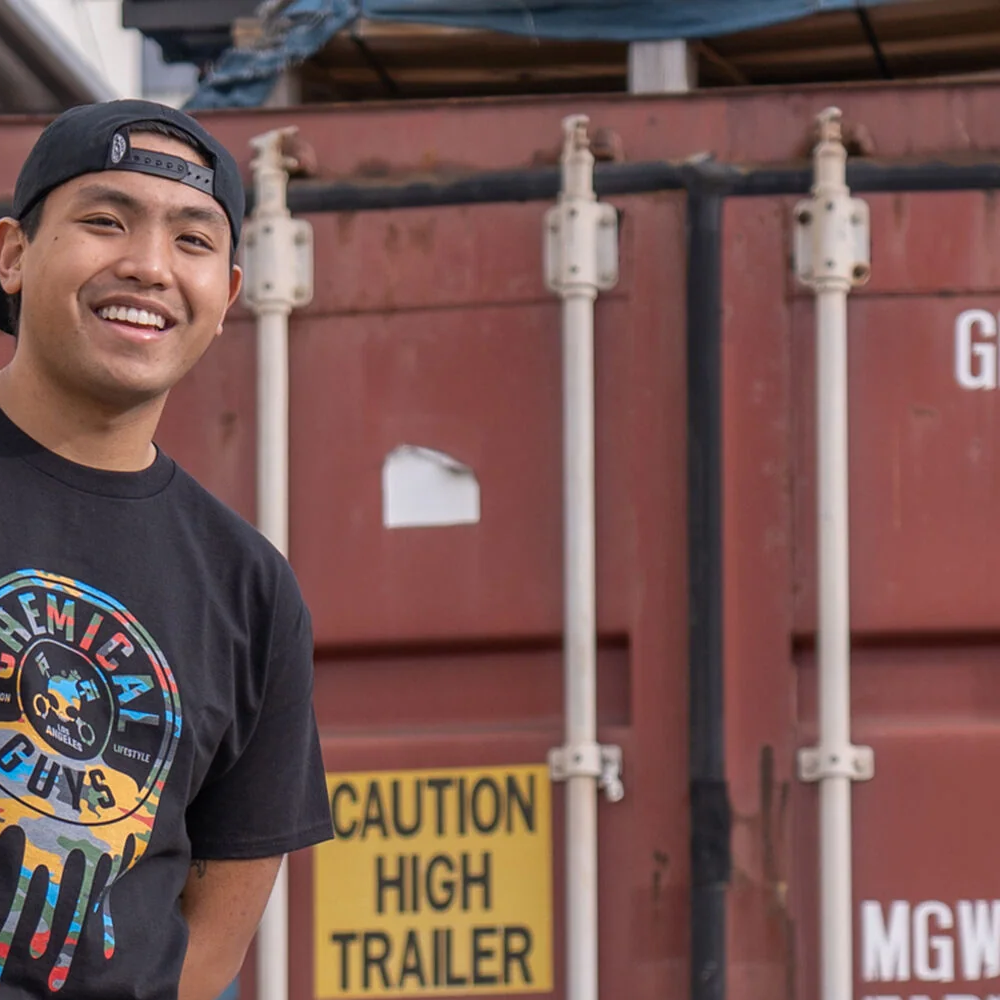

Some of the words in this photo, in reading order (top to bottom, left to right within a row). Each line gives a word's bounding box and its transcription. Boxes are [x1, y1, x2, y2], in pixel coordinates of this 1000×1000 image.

[955, 308, 1000, 390] G
[45, 724, 84, 753] ANGELES
[56, 723, 71, 737] LOS
[113, 743, 151, 763] LIFESTYLE
[331, 774, 536, 841] CAUTION
[375, 852, 492, 915] HIGH
[331, 925, 534, 992] TRAILER
